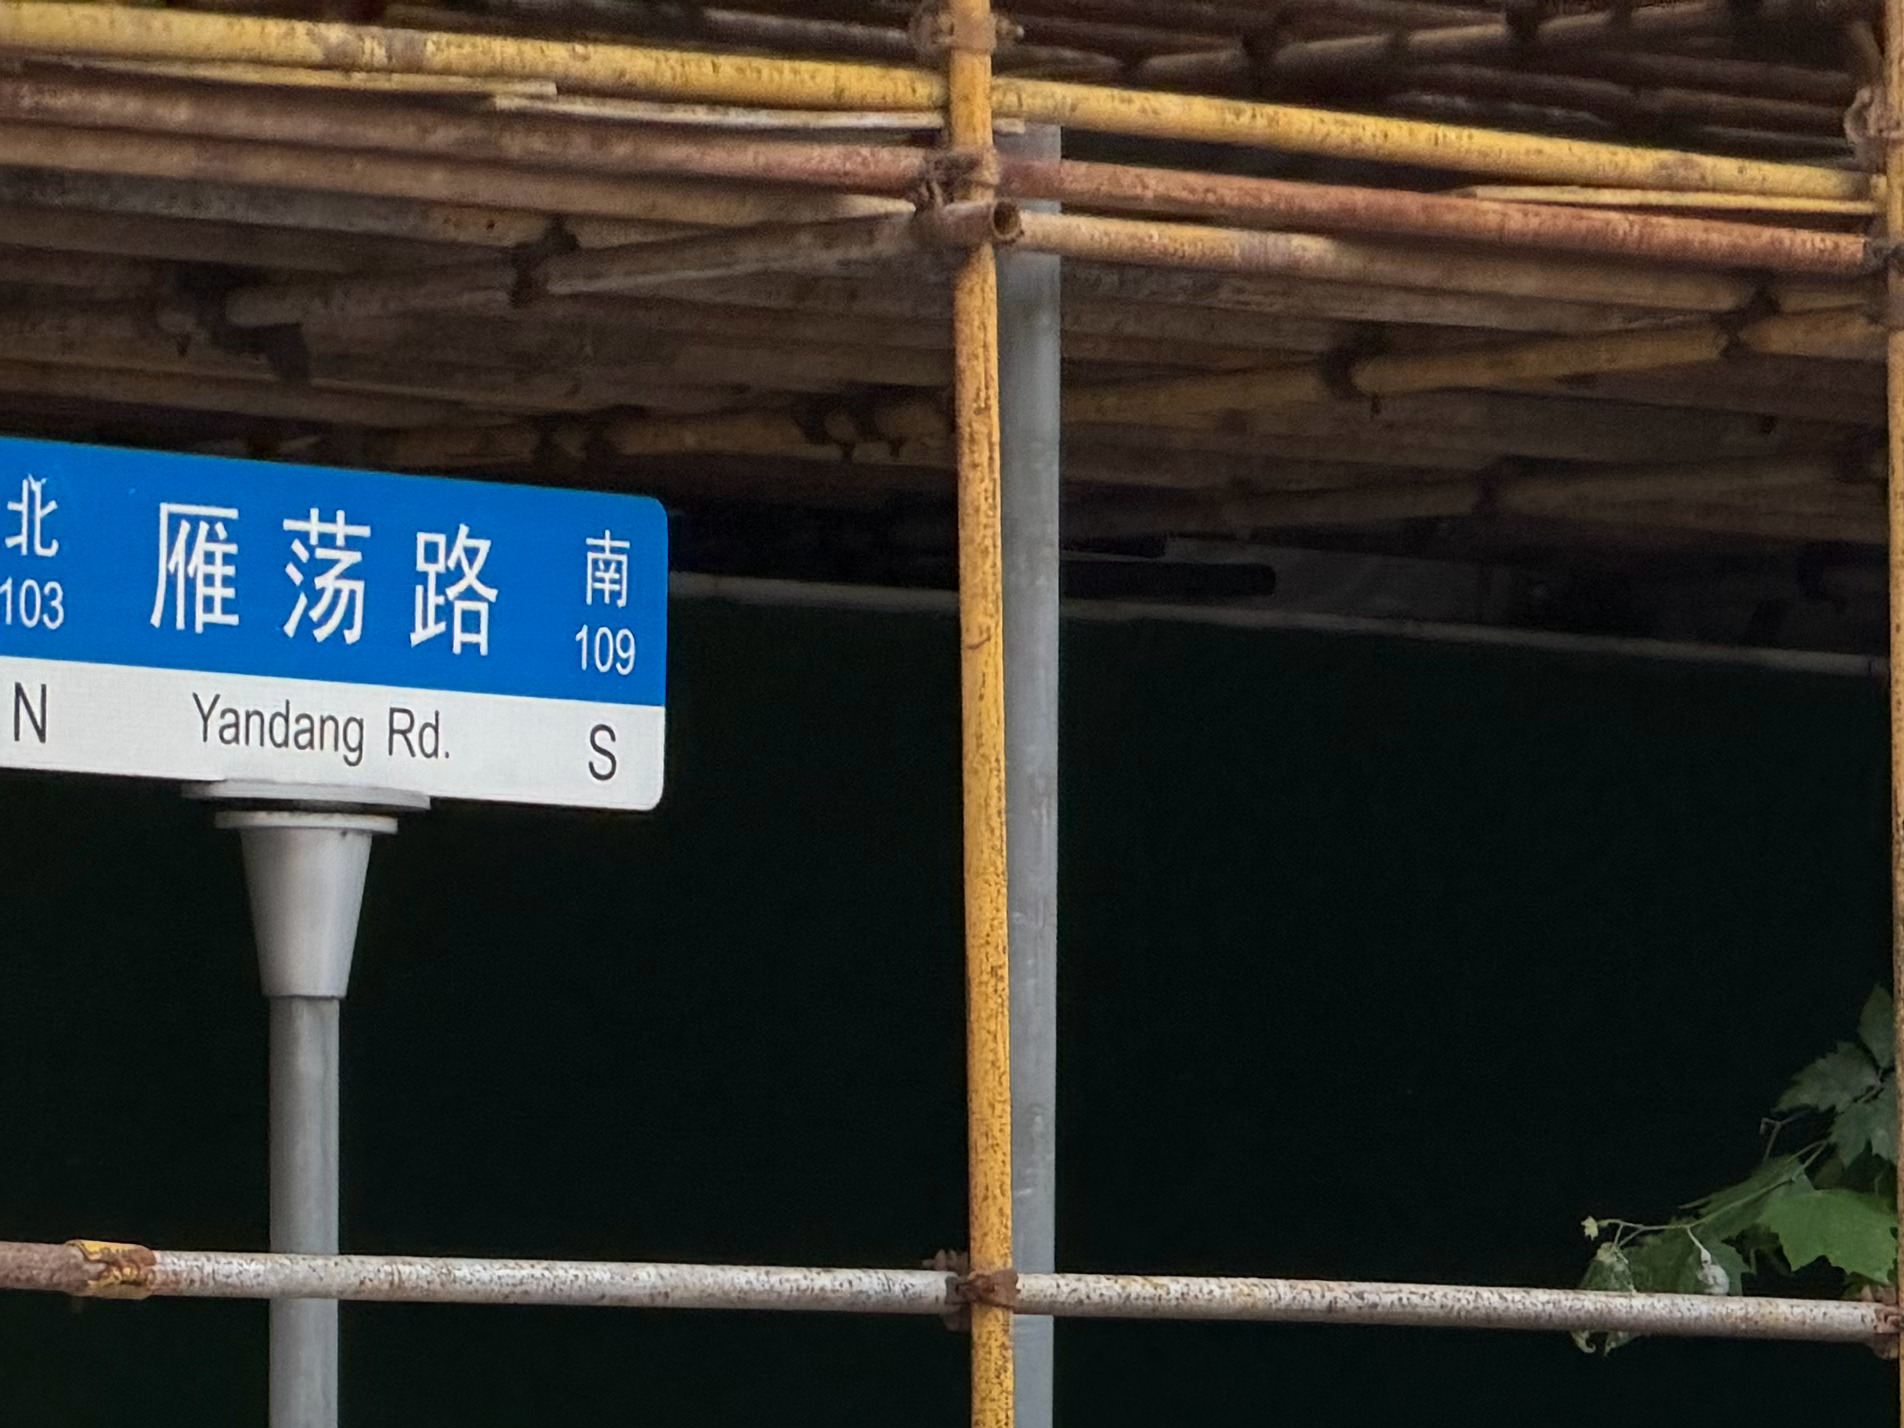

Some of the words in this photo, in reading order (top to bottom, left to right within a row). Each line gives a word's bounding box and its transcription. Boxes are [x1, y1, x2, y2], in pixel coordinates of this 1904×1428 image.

[5, 474, 59, 557] 北
[0, 577, 65, 630] 103
[150, 502, 499, 657] 雁荡路
[585, 530, 630, 608] 南
[575, 624, 636, 675] 109
[13, 681, 47, 744] N
[192, 692, 365, 767] Yandang
[388, 707, 451, 759] Rd.
[588, 723, 618, 781] S
